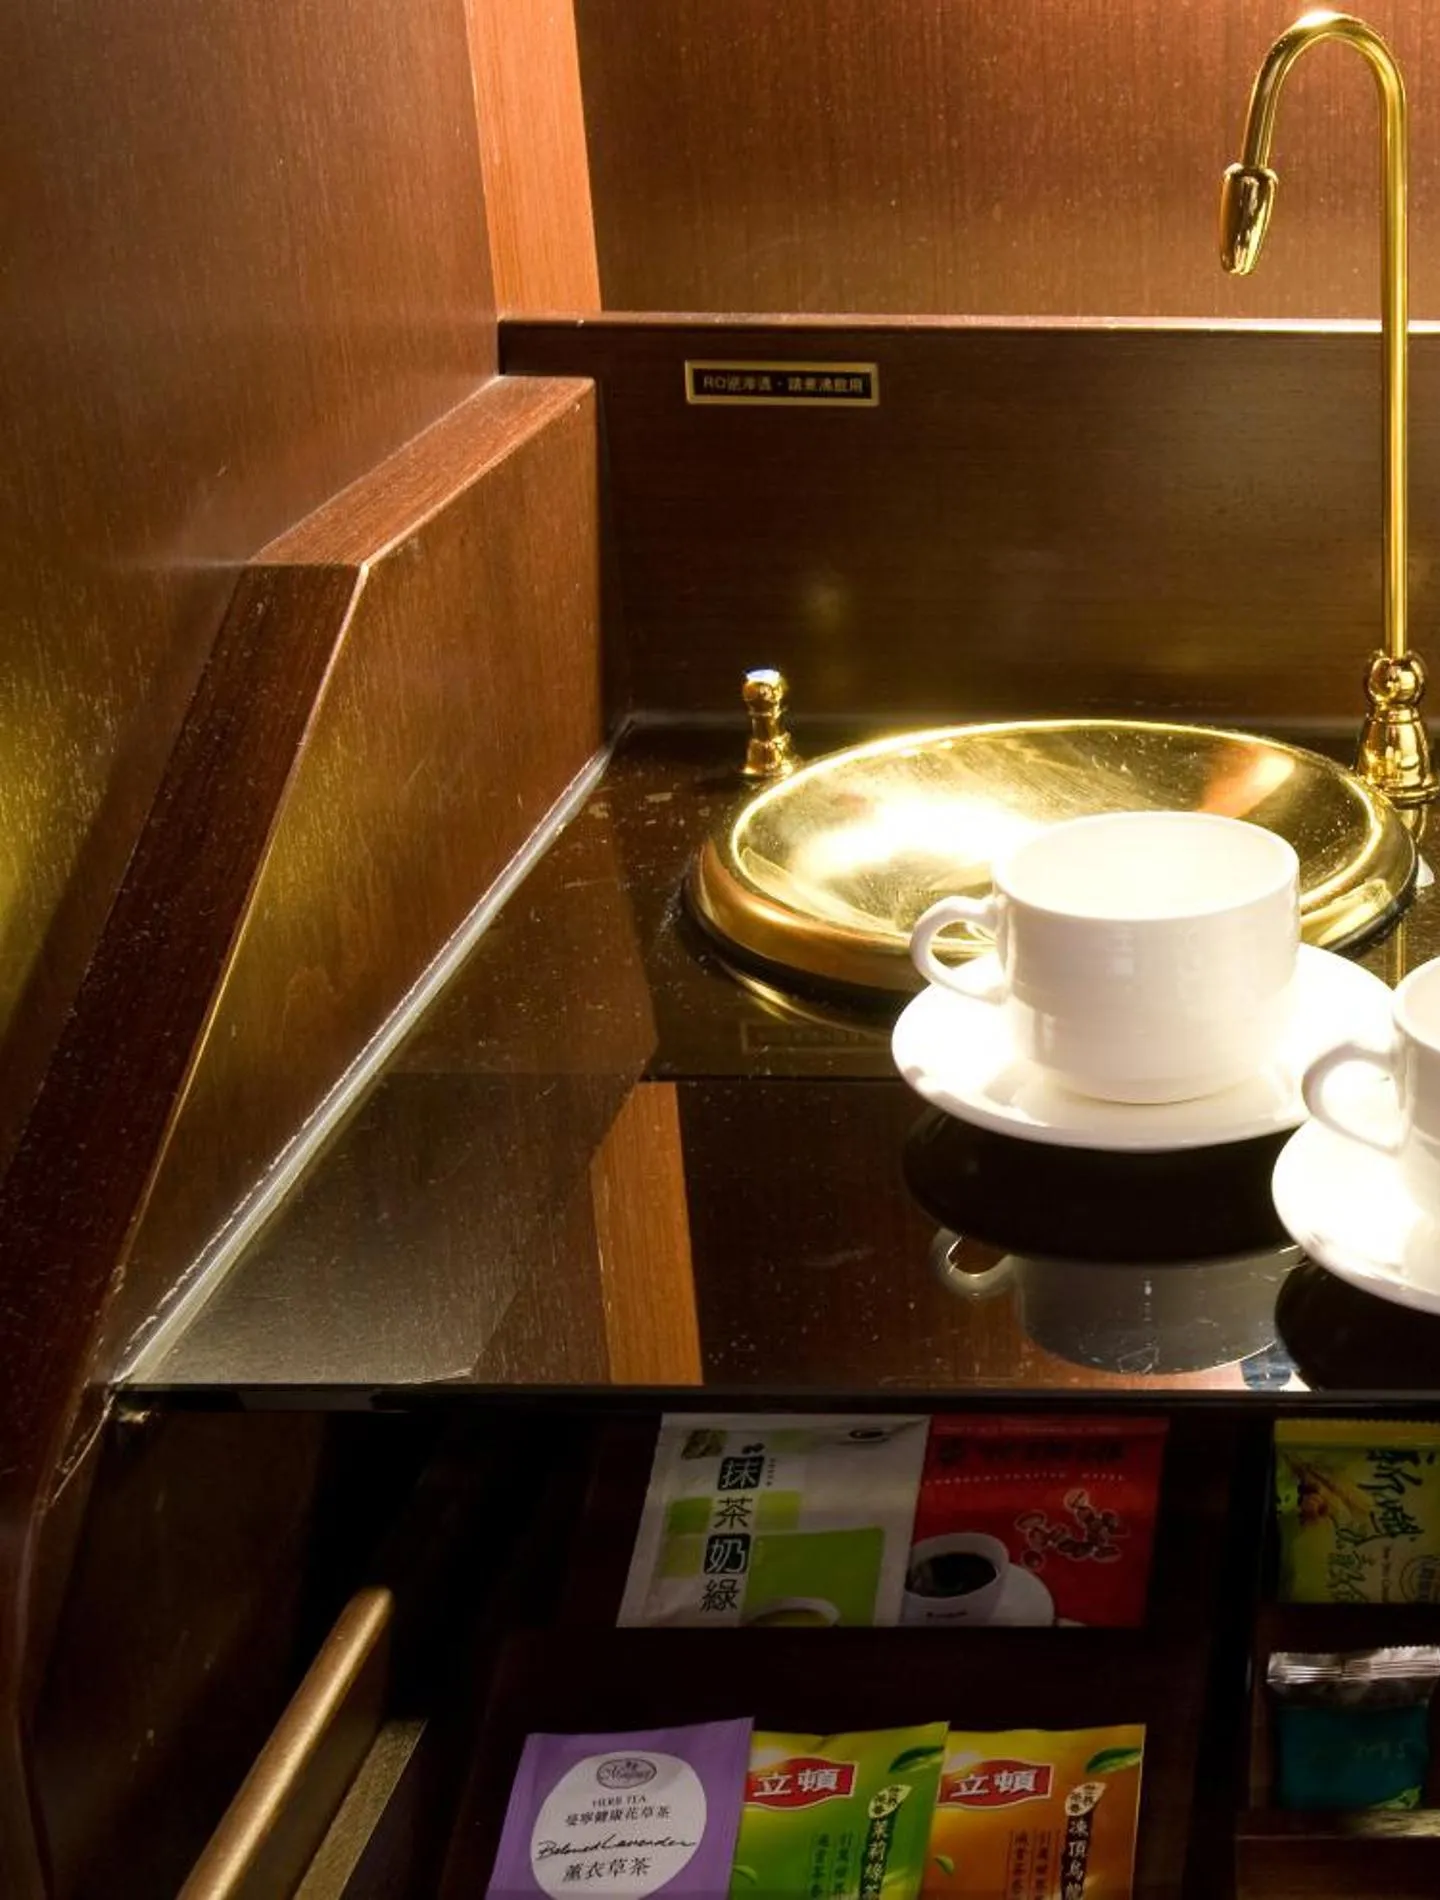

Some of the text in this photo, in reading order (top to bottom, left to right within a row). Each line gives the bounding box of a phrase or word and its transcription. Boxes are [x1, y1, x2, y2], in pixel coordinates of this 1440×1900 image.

[700, 1457, 761, 1613] 抹茶奶綠
[752, 1767, 841, 1798] 立頓
[950, 1767, 1039, 1798] 立頓
[626, 1794, 647, 1805] TEA
